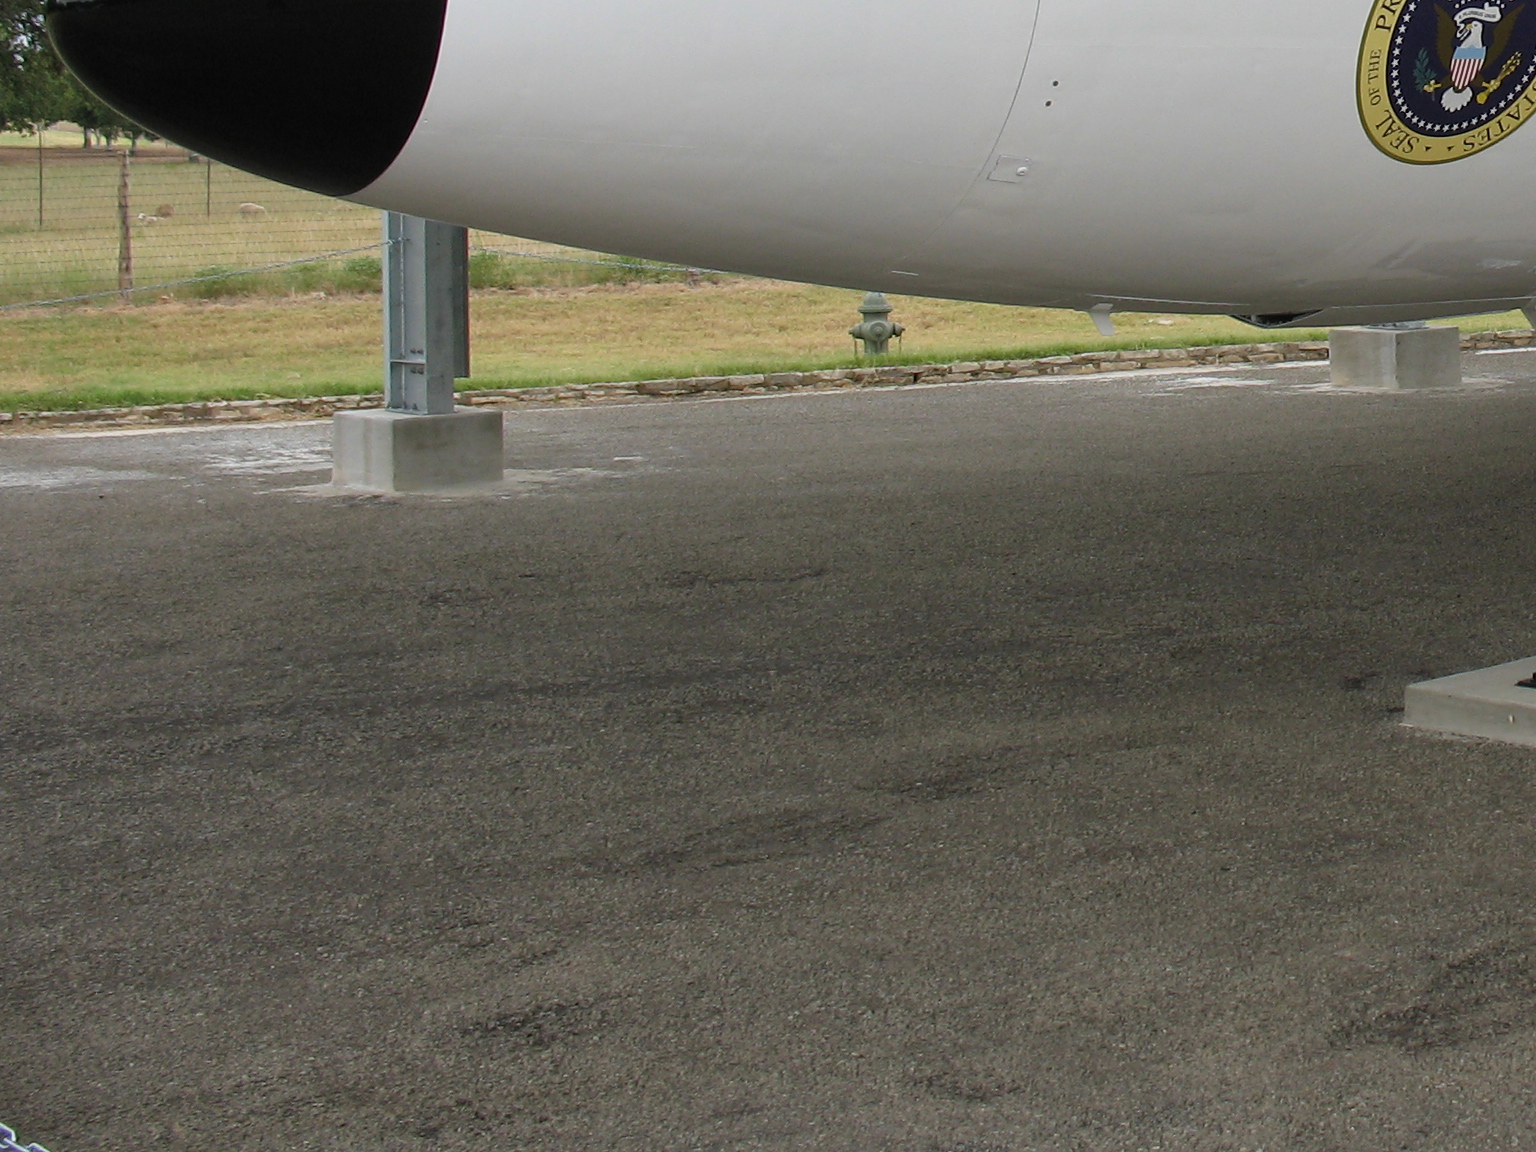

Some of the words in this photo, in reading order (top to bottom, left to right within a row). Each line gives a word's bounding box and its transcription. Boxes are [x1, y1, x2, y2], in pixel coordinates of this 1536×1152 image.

[1367, 48, 1382, 83] THE
[1369, 84, 1382, 106] OF
[1375, 109, 1421, 154] SEAL
